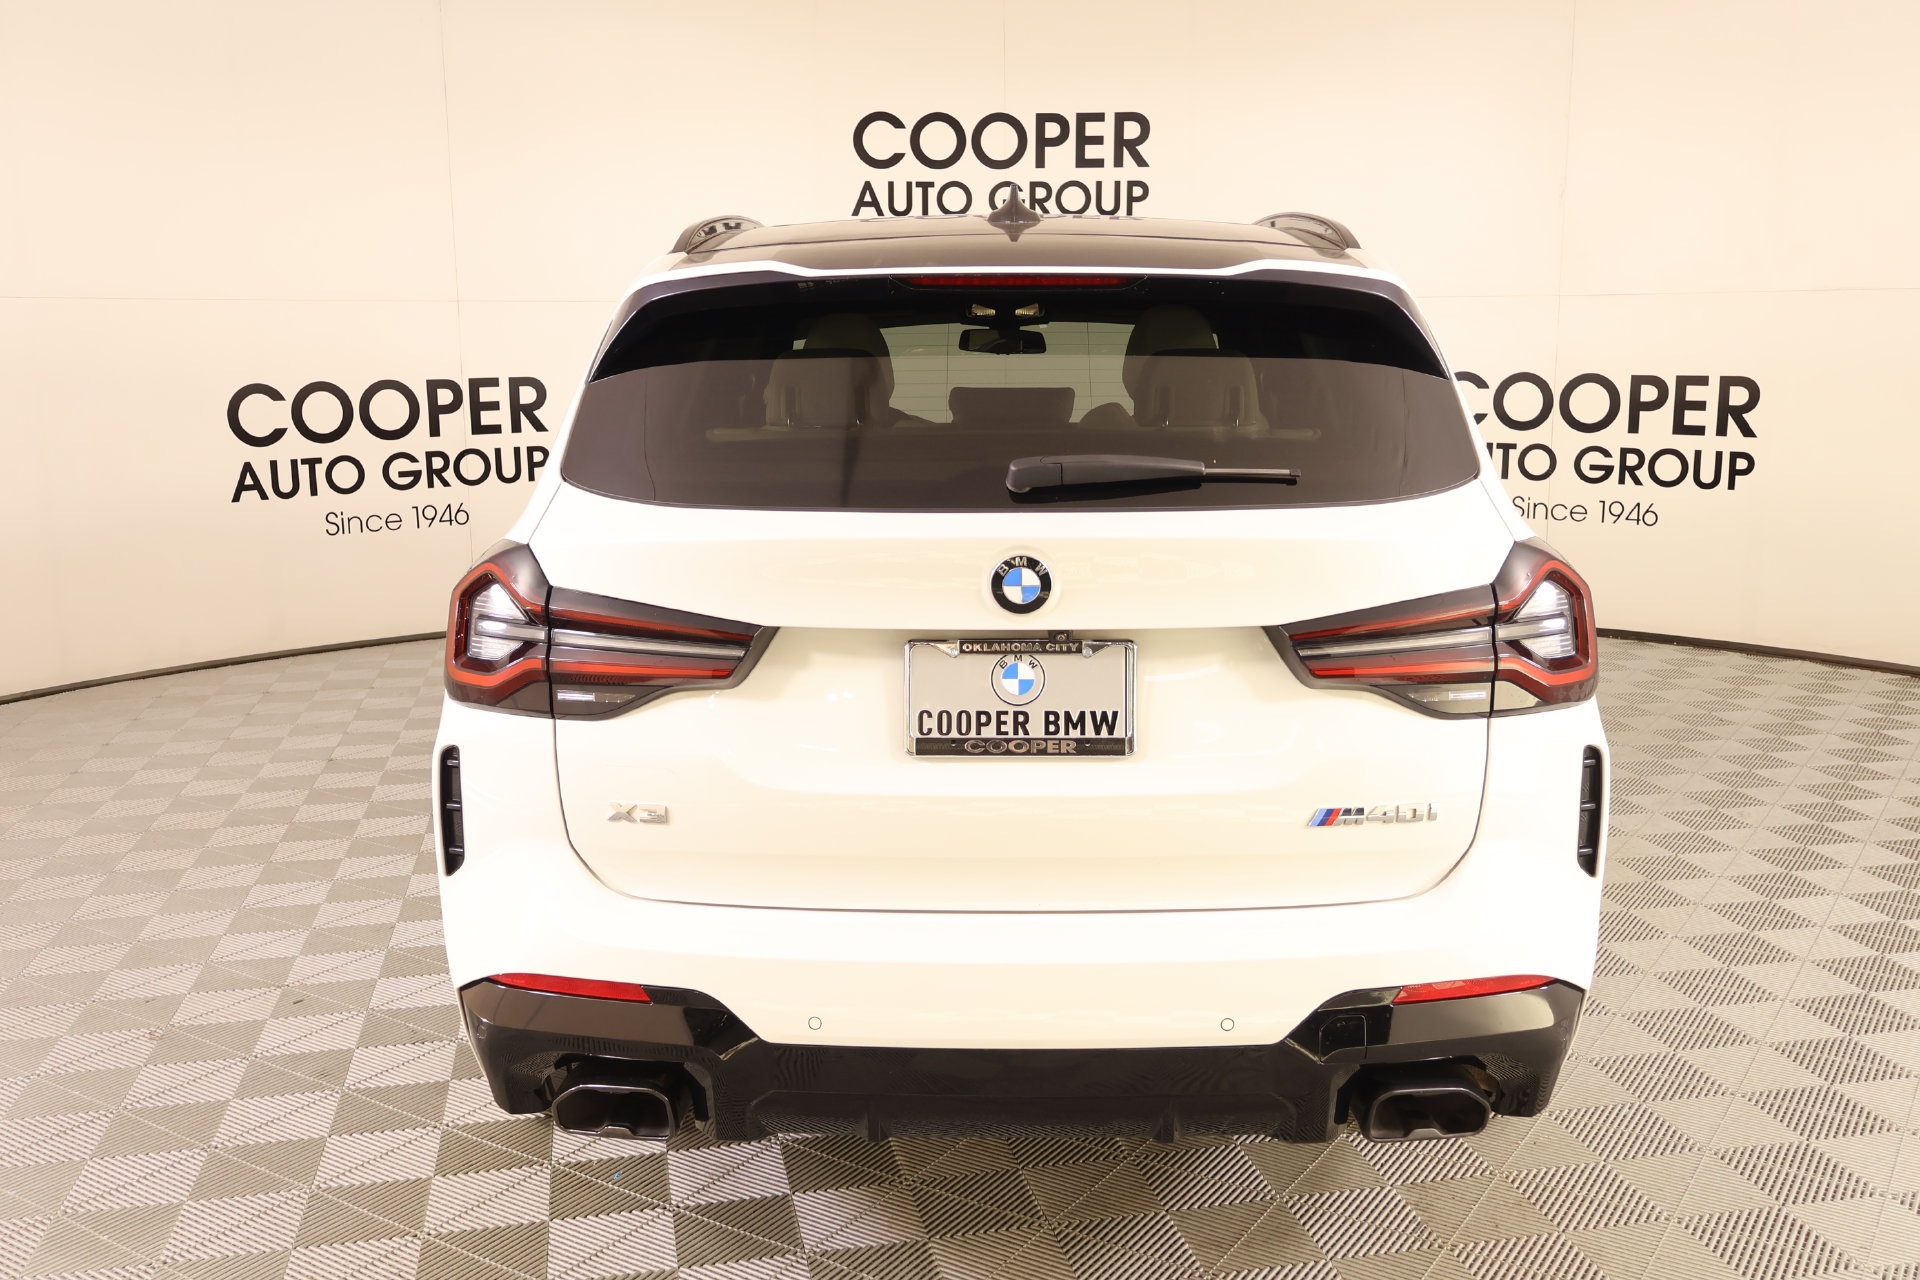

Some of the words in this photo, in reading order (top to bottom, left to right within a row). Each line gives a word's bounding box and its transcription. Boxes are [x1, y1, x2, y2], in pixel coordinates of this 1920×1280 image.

[853, 111, 1151, 169] COOPER
[851, 180, 973, 217] AUTO
[227, 376, 549, 447] COOPER
[231, 454, 365, 503] AUTO
[382, 445, 550, 491] GROUP
[1573, 445, 1756, 490] GROUP
[325, 511, 403, 536] Since
[411, 502, 470, 529] 1946
[1512, 495, 1588, 522] Since
[1598, 500, 1658, 527] 1946
[998, 556, 1048, 577] BMW
[962, 642, 1043, 652] OKLAHOMA
[1045, 642, 1081, 652] CITY
[999, 654, 1038, 670] BMW
[917, 709, 1031, 737] COOPER
[1044, 710, 1120, 736] BMW
[964, 739, 1078, 754] COOPER
[607, 802, 668, 825] X3
